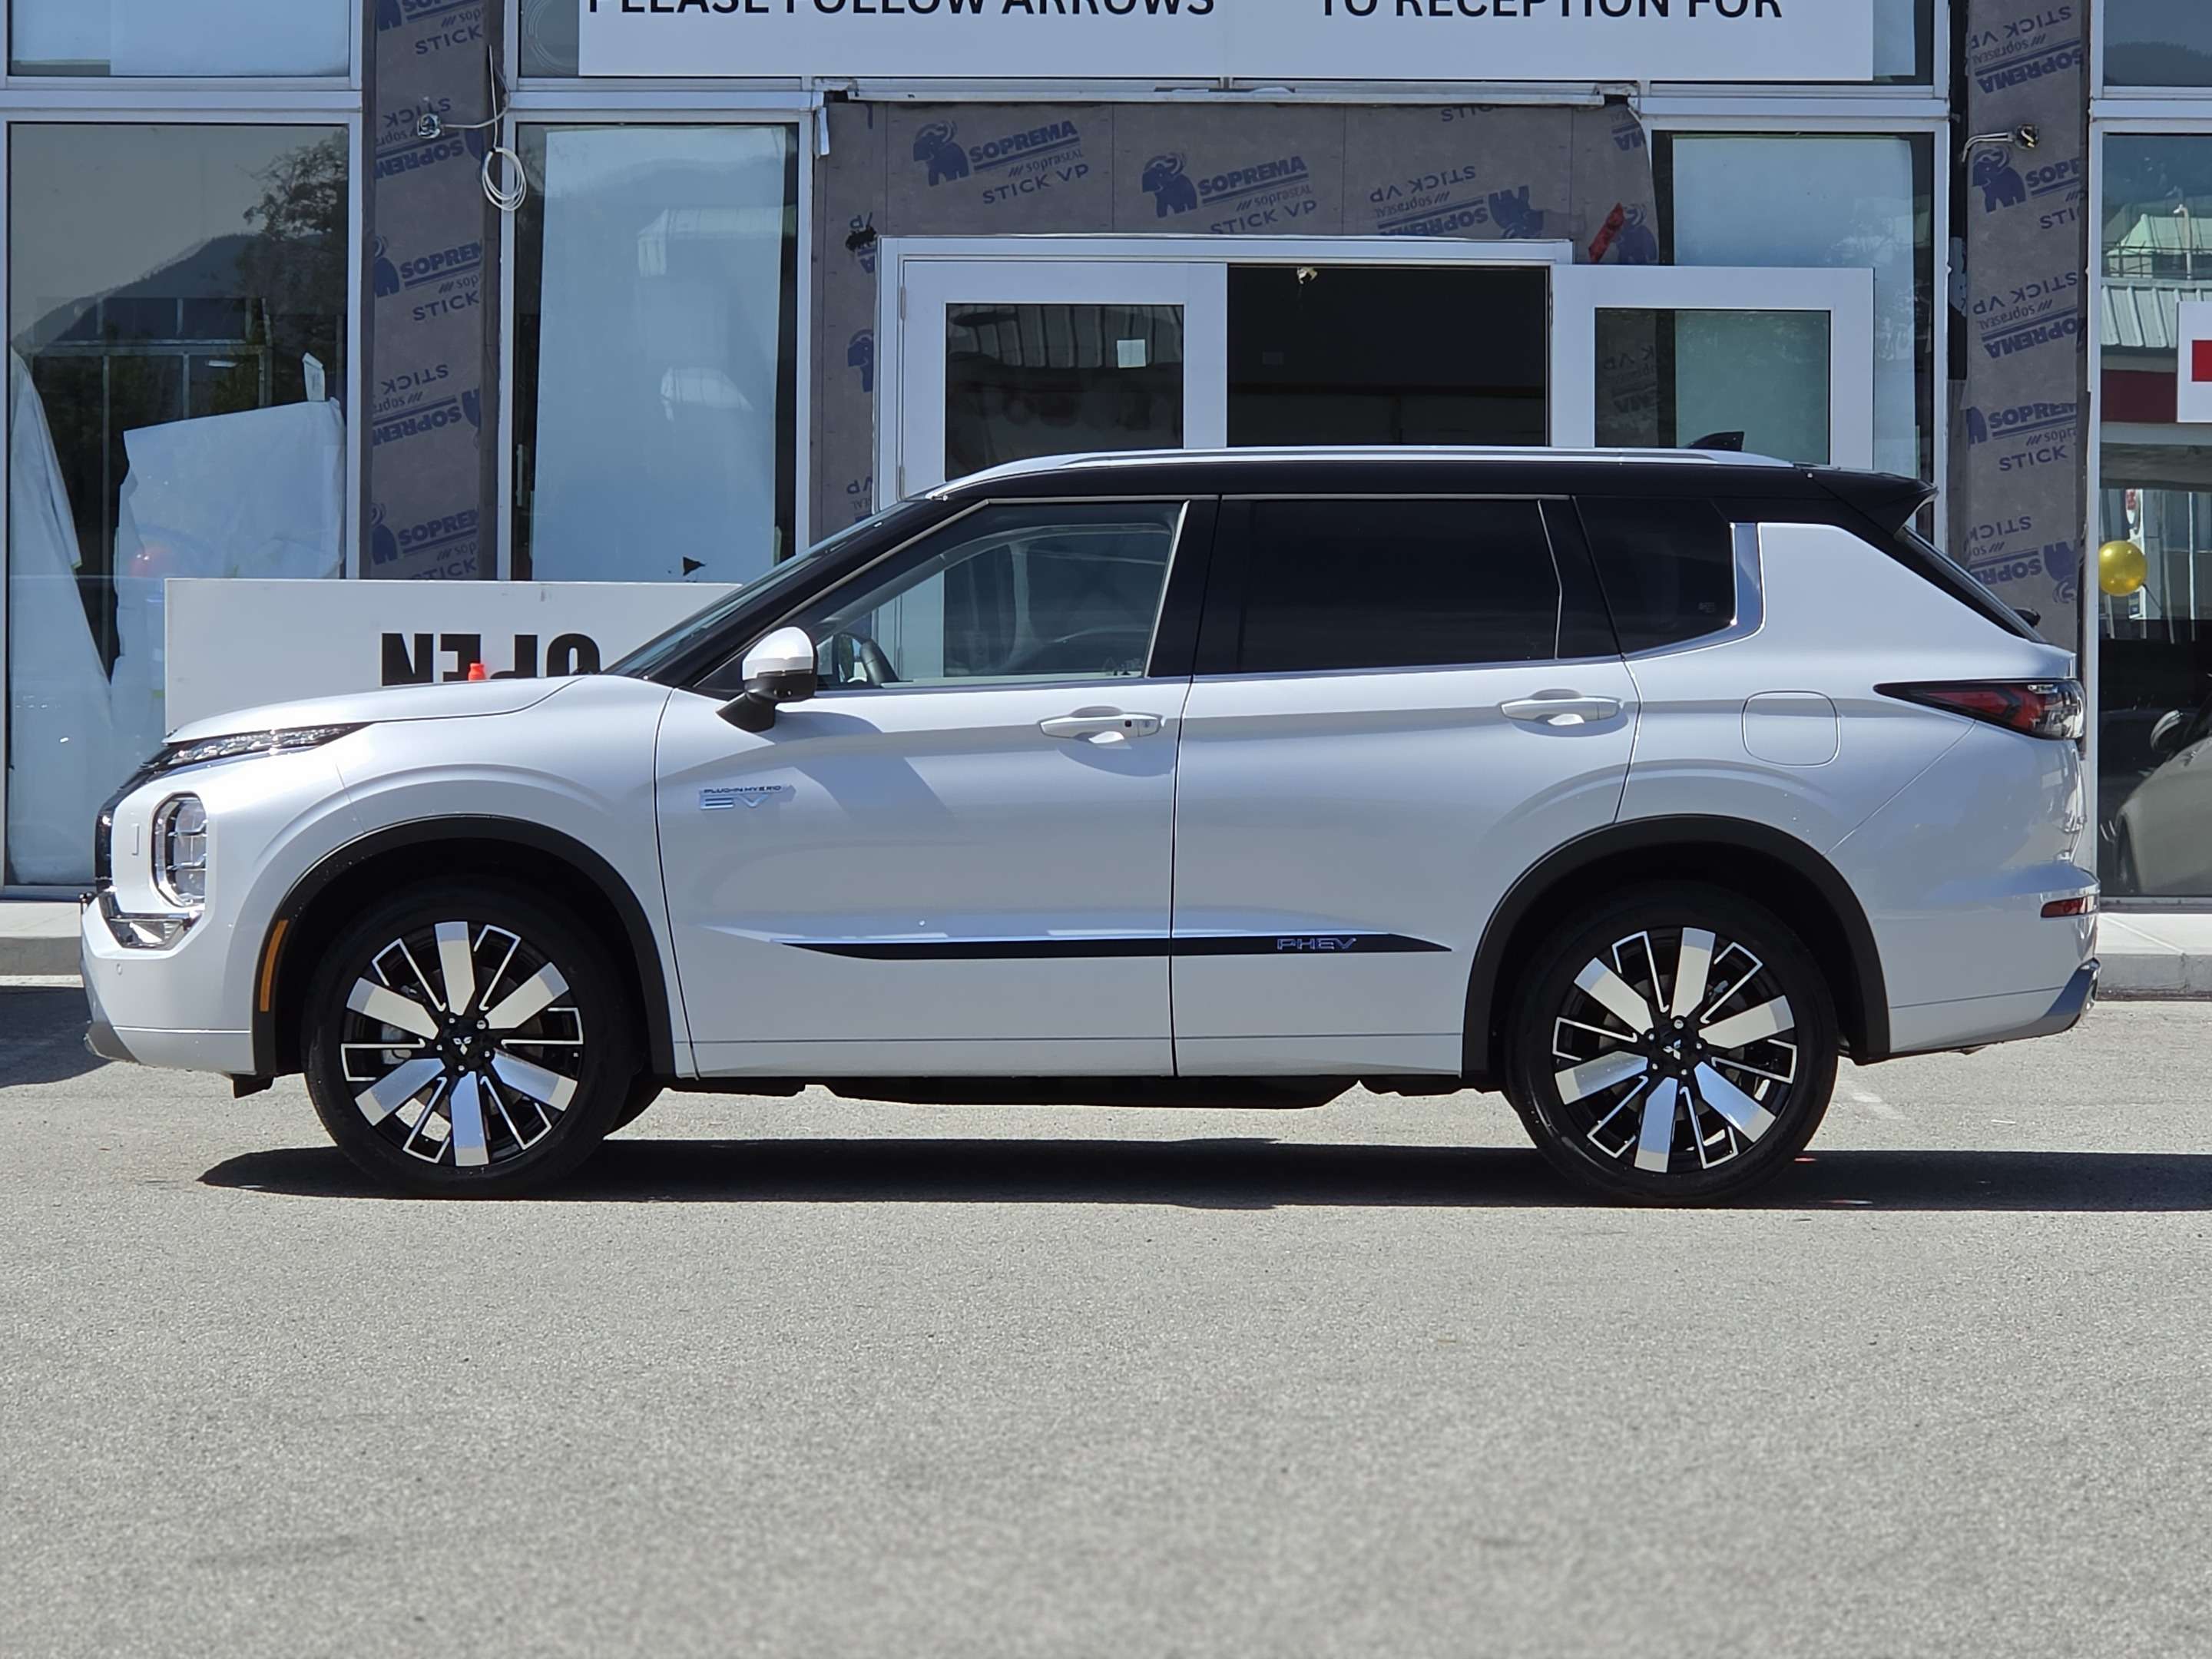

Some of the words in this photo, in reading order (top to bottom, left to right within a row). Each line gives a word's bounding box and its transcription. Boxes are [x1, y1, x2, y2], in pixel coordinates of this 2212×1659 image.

[2003, 6, 2072, 38] STICK
[415, 24, 483, 55] STICK
[969, 121, 1078, 163] SOPREMA
[982, 174, 1051, 204] STICK
[1056, 163, 1089, 182] VP
[1197, 156, 1307, 196] SOPREMA
[1407, 165, 1475, 194] STICK
[1370, 184, 1402, 202] VP
[1210, 208, 1279, 235] STICK
[1284, 200, 1317, 217] VP
[2009, 271, 2078, 304] STICK
[412, 290, 480, 321] STICK
[1972, 296, 2005, 315] VP
[381, 364, 449, 395] STICK
[1999, 445, 2068, 471] STICK
[1277, 937, 1357, 951] PHEV
